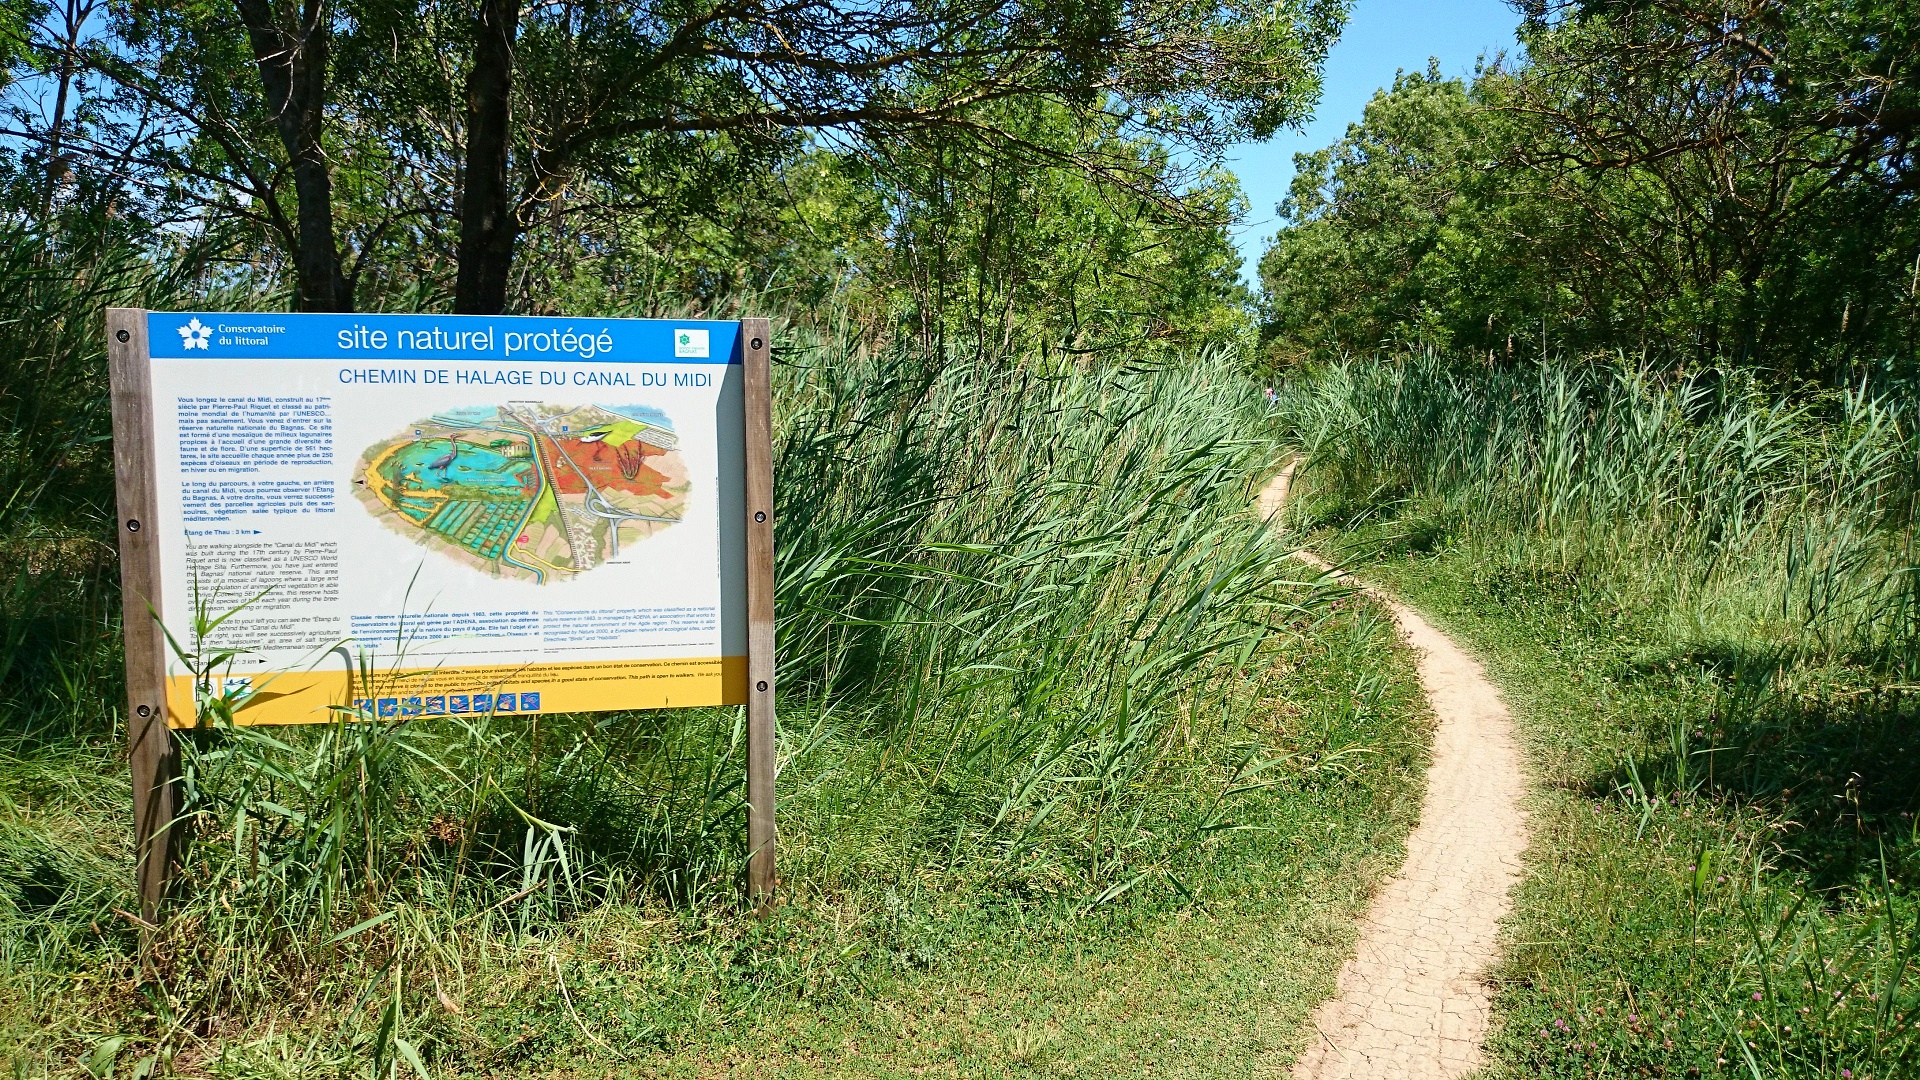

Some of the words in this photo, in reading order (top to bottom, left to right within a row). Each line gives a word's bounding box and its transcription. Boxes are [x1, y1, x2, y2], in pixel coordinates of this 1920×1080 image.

[218, 324, 286, 333] Conservatoire
[219, 336, 232, 345] du
[235, 336, 268, 345] littoral
[338, 324, 388, 349] site
[398, 326, 494, 350] naturel
[504, 327, 612, 358] protégé
[339, 369, 416, 384] CHEMIN
[424, 370, 449, 384] DE
[456, 370, 533, 384] HALAGE
[540, 372, 566, 386] DU
[573, 372, 635, 386] CANAL
[642, 373, 667, 386] DU
[674, 373, 711, 386] MIDI
